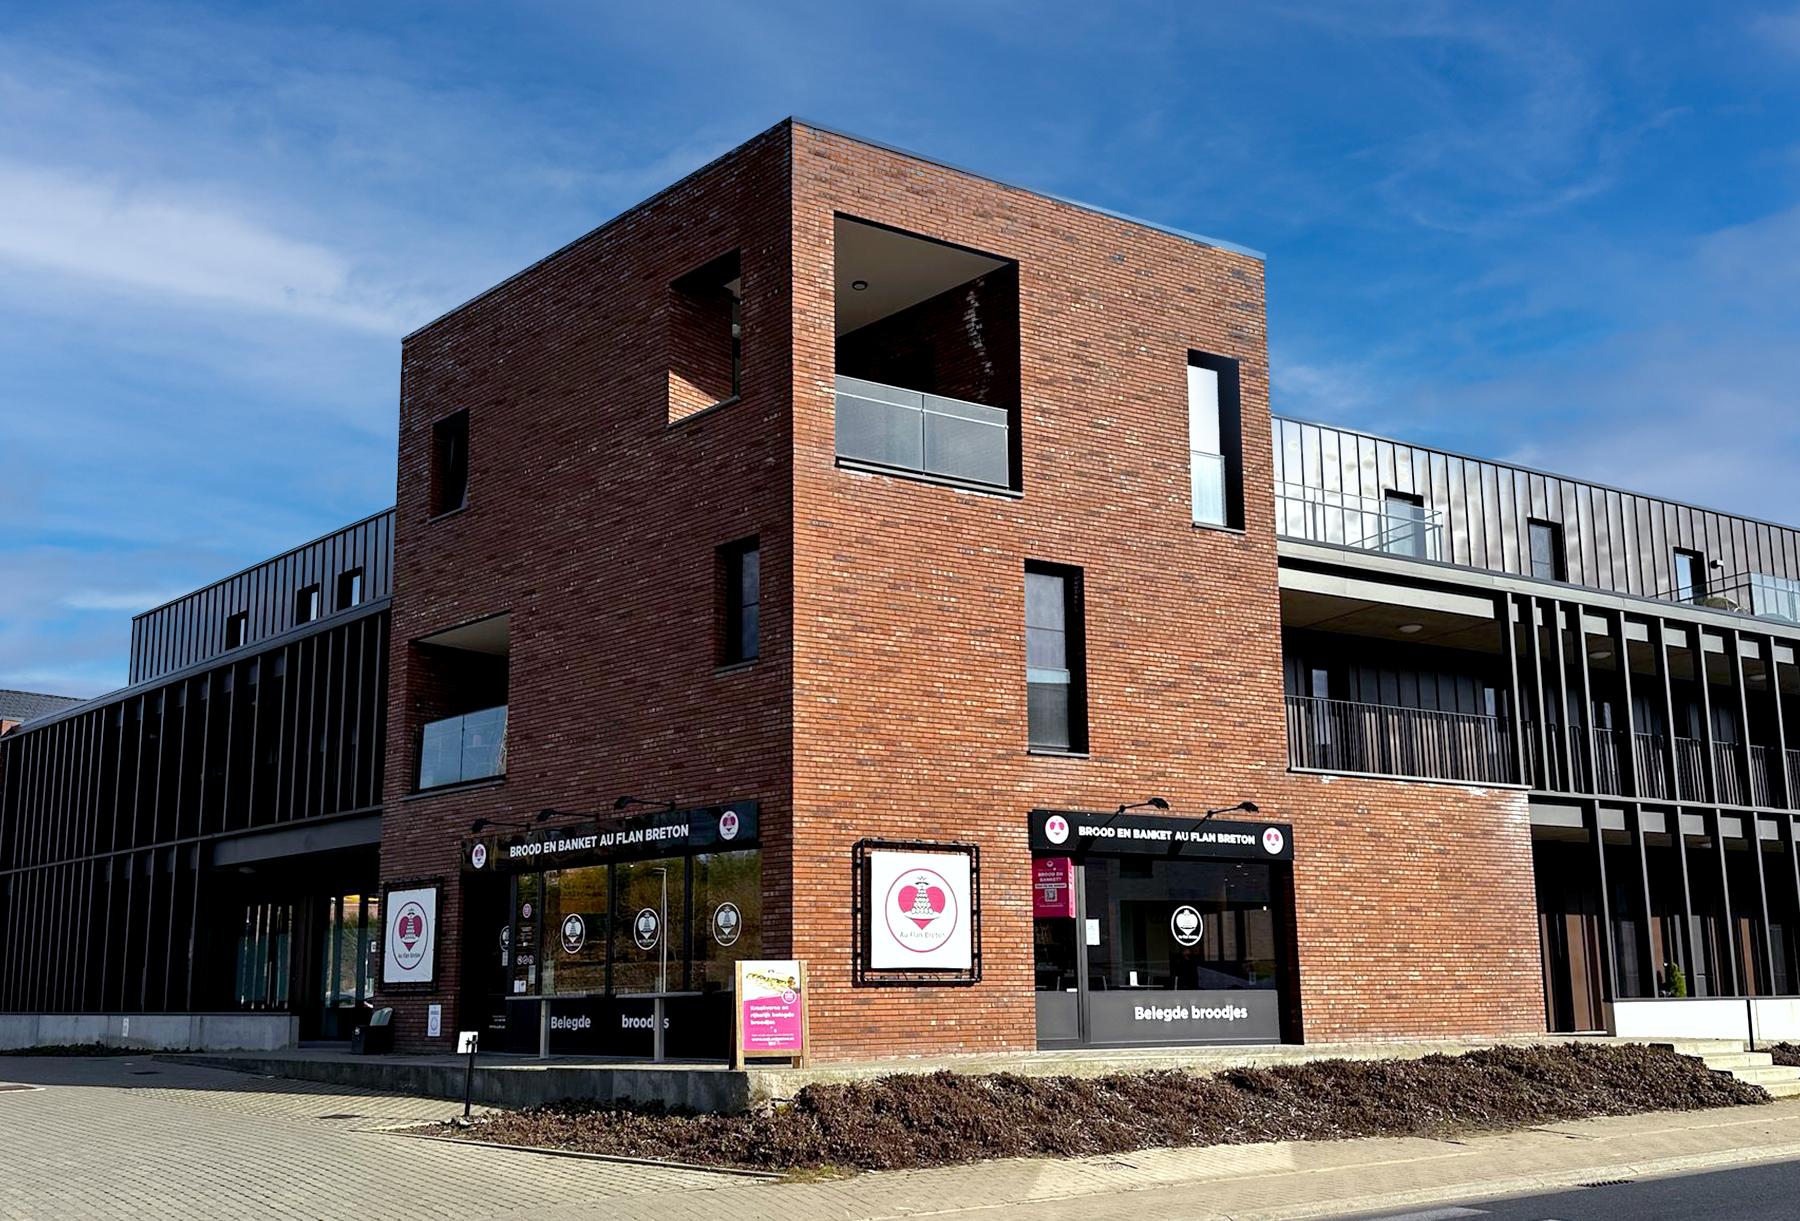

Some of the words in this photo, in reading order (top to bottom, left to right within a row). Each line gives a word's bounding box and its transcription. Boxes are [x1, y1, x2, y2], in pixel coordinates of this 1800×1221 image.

[510, 843, 542, 858] BROOD
[543, 840, 557, 854] EN
[558, 835, 598, 852] BANKET
[600, 833, 614, 847] AU
[616, 829, 644, 845] FLAN
[645, 823, 689, 841] BRETON
[1078, 825, 1116, 838] BROOD
[1116, 828, 1132, 839] EN
[1133, 828, 1173, 841] BANKET
[1174, 830, 1189, 841] AU
[1190, 831, 1216, 843] FLAN
[1217, 833, 1256, 845] BRETON
[1134, 1005, 1189, 1021] Belegde
[1191, 1005, 1248, 1021] broodjes
[550, 1015, 591, 1031] Belegde
